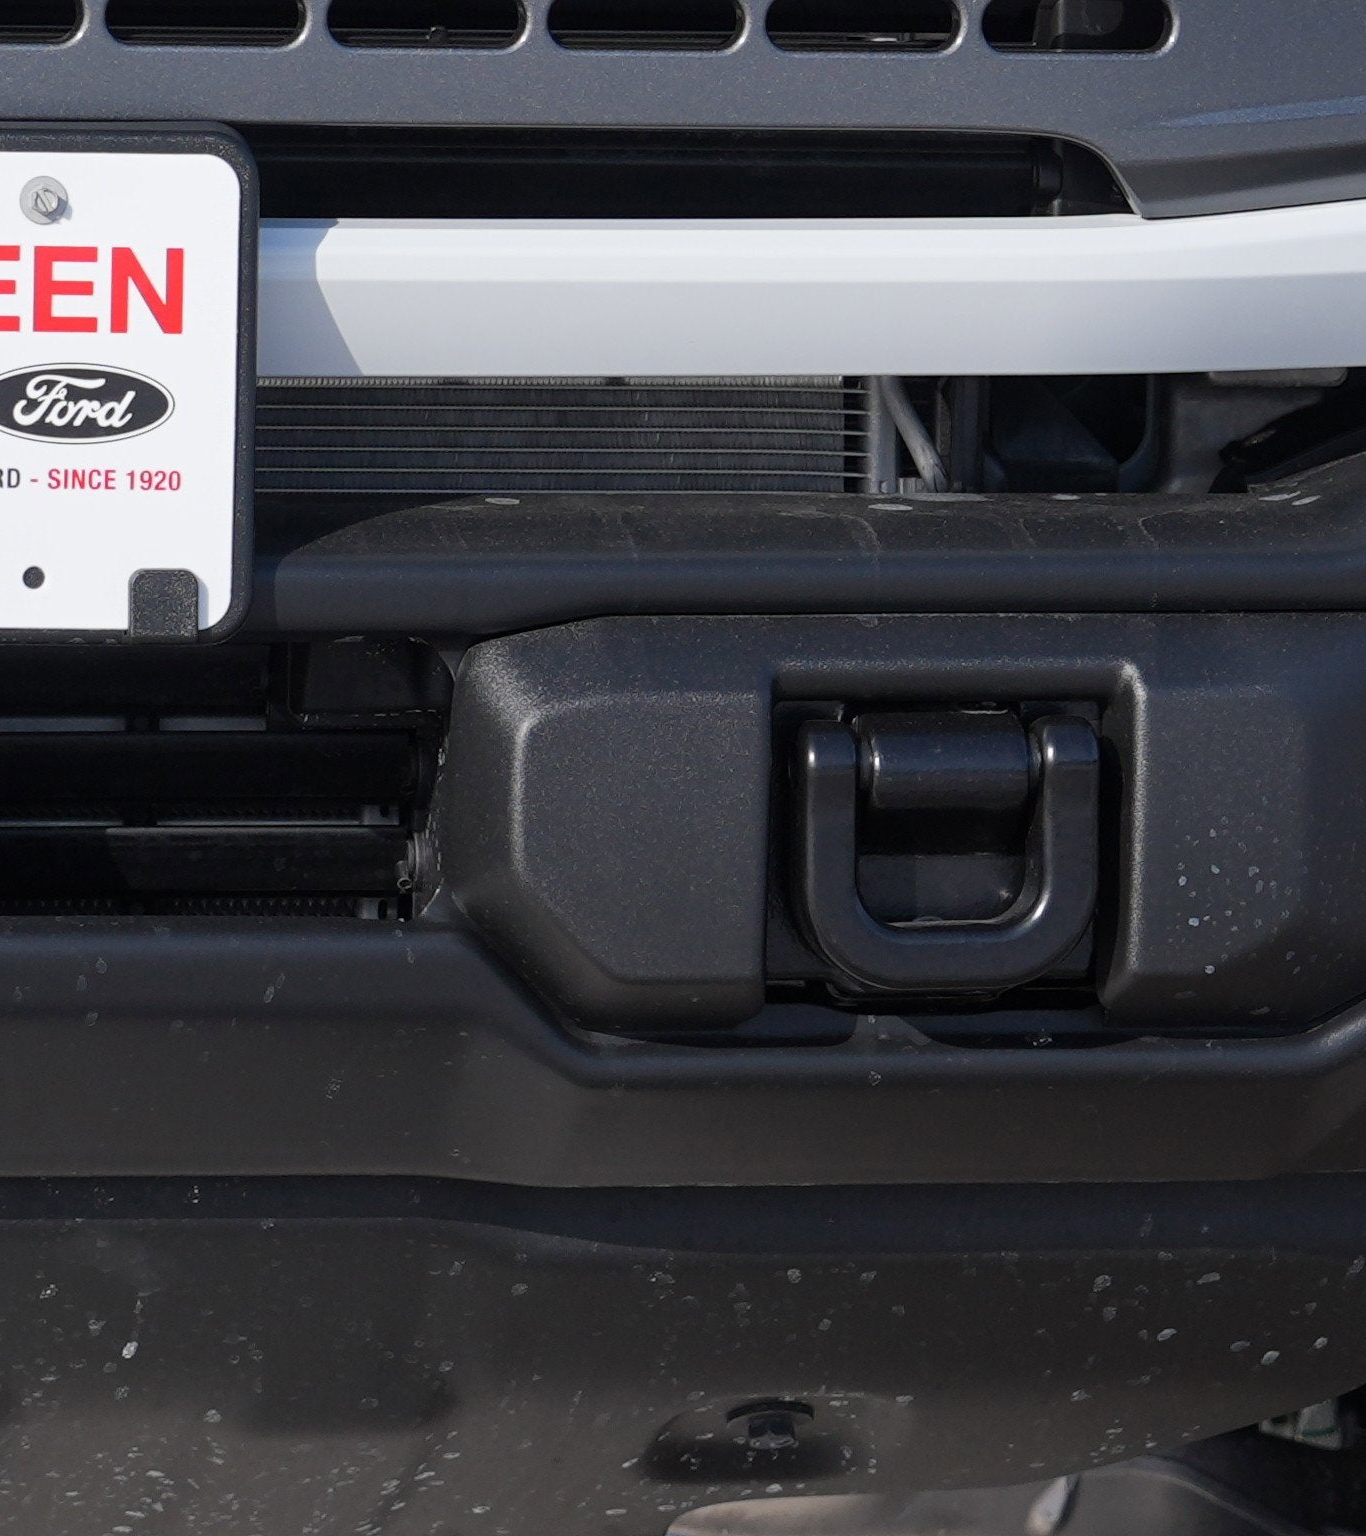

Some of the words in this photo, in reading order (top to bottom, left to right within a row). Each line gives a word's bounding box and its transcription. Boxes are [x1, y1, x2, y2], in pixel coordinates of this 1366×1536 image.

[12, 375, 135, 431] Ford
[47, 468, 116, 490] SINCE
[127, 470, 181, 491] 1920
